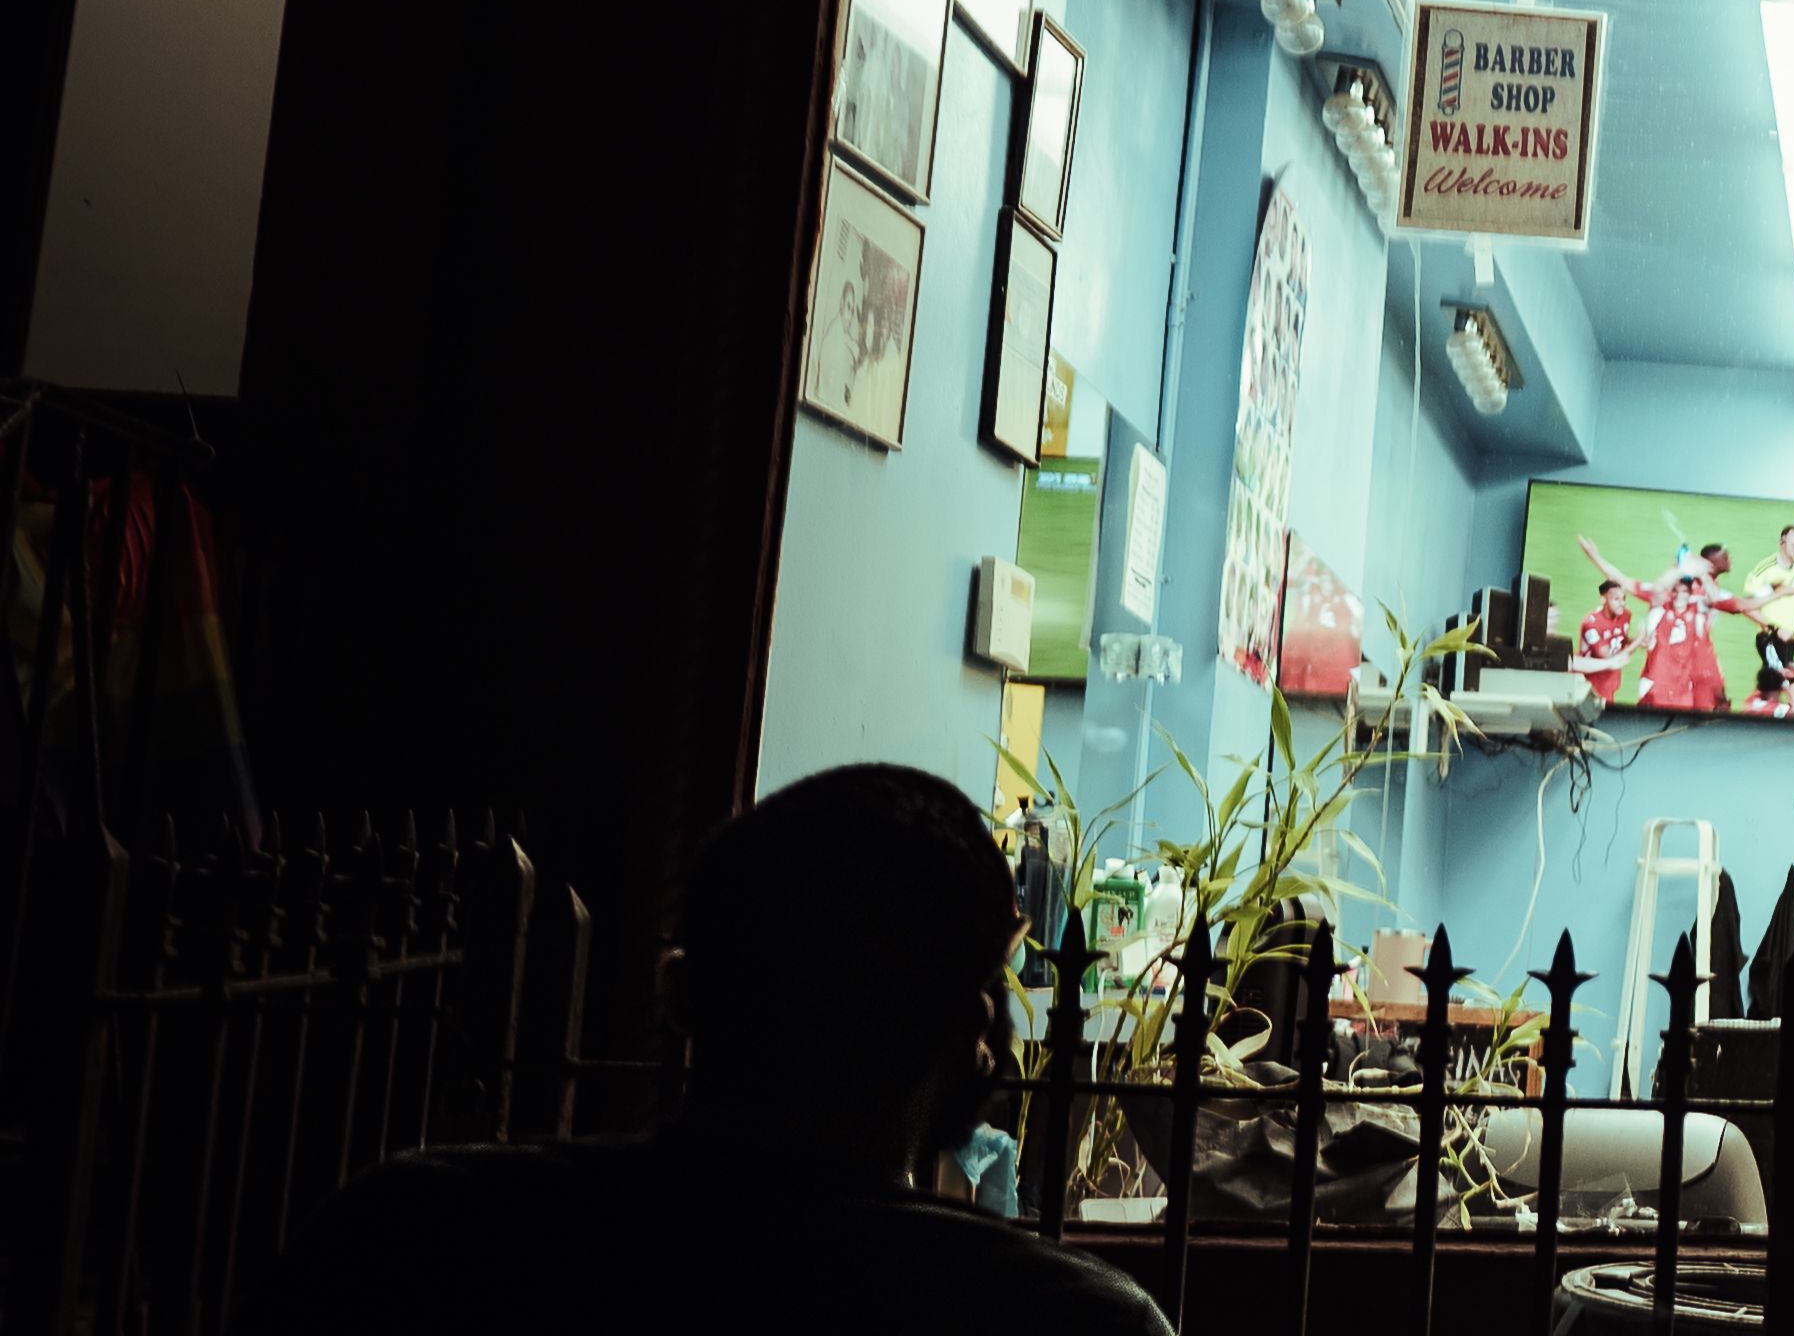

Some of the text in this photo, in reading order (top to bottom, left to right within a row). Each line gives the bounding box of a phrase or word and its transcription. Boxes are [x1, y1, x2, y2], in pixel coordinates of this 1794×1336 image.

[1473, 41, 1576, 79] BARBER
[1490, 82, 1556, 114] SHOP
[1429, 119, 1569, 160] WALK-INS
[1423, 165, 1569, 201] Welcome
